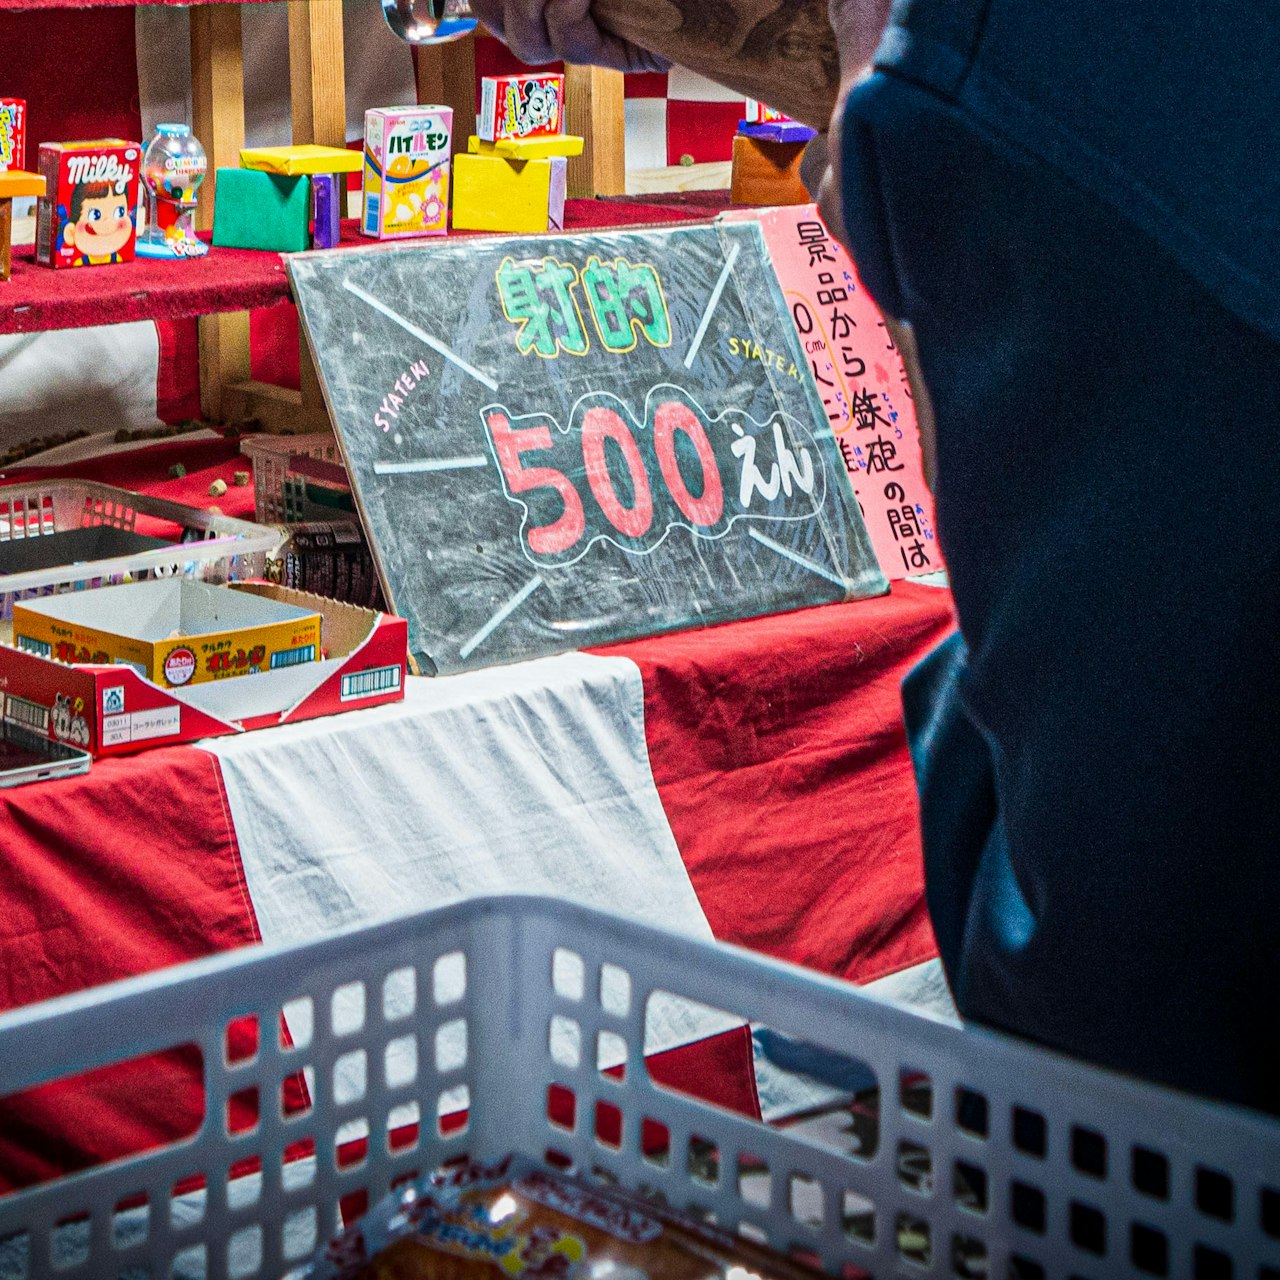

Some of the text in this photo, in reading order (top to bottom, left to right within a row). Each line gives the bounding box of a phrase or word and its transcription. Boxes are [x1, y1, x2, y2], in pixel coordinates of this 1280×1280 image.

[67, 154, 134, 195] Milky
[495, 255, 672, 359] 射的
[374, 359, 430, 433] SYATEKI
[728, 337, 806, 385] SYATEKI
[796, 220, 931, 572] 景品から鉄砲の間は
